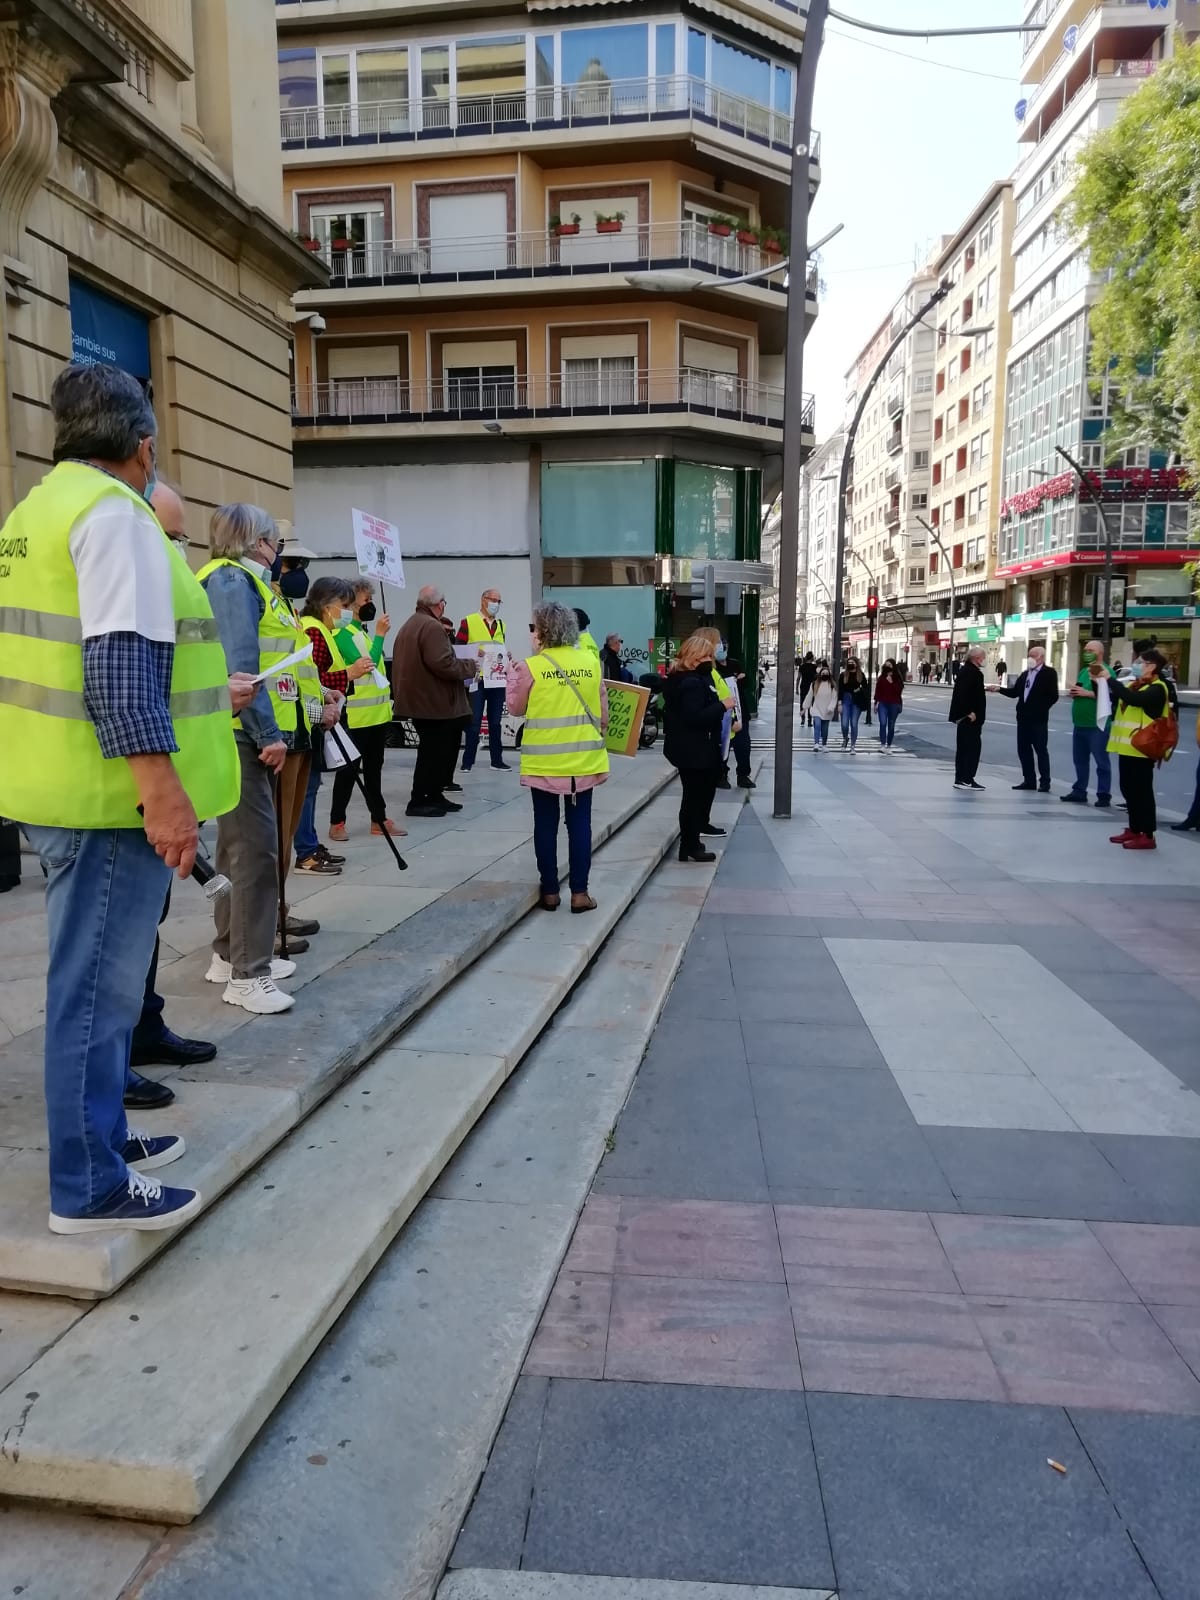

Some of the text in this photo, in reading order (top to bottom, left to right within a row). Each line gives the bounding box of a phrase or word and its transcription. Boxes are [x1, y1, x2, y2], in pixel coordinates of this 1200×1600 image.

[102, 346, 117, 361] sus
[541, 669, 593, 680] YAYLAUTAS
[608, 714, 630, 727] RIA
[607, 725, 626, 739] OS
